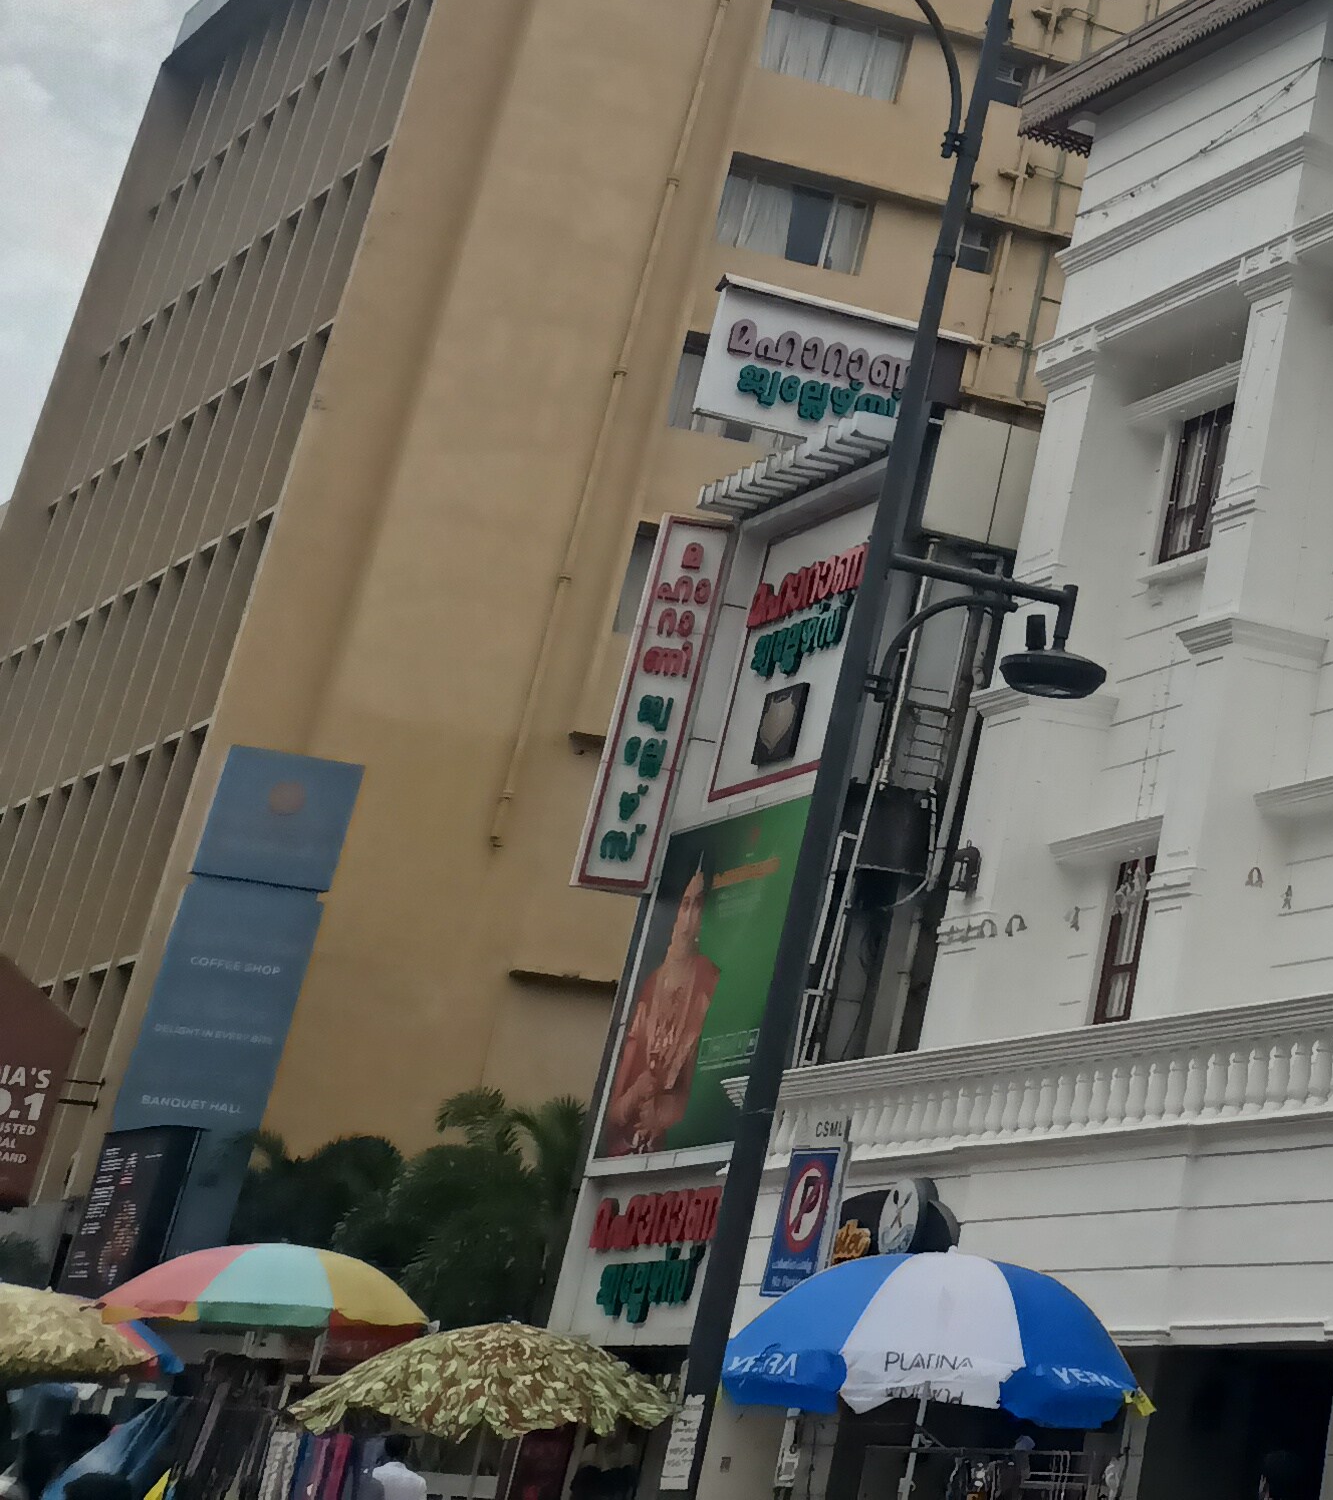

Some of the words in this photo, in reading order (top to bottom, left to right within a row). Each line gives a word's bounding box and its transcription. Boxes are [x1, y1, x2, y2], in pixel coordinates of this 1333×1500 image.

[727, 319, 911, 392] മഹാറാണ
[747, 542, 870, 629] മഹാറാണ
[190, 956, 241, 971] COFFEE
[244, 963, 281, 976] SHOP
[0, 1064, 51, 1089] IA'S
[140, 1094, 207, 1110] BANQUET
[209, 1102, 242, 1114] HALL
[815, 1120, 843, 1138] CSML
[588, 1184, 723, 1251] മഹാറാണ
[884, 1350, 973, 1373] PLATINA
